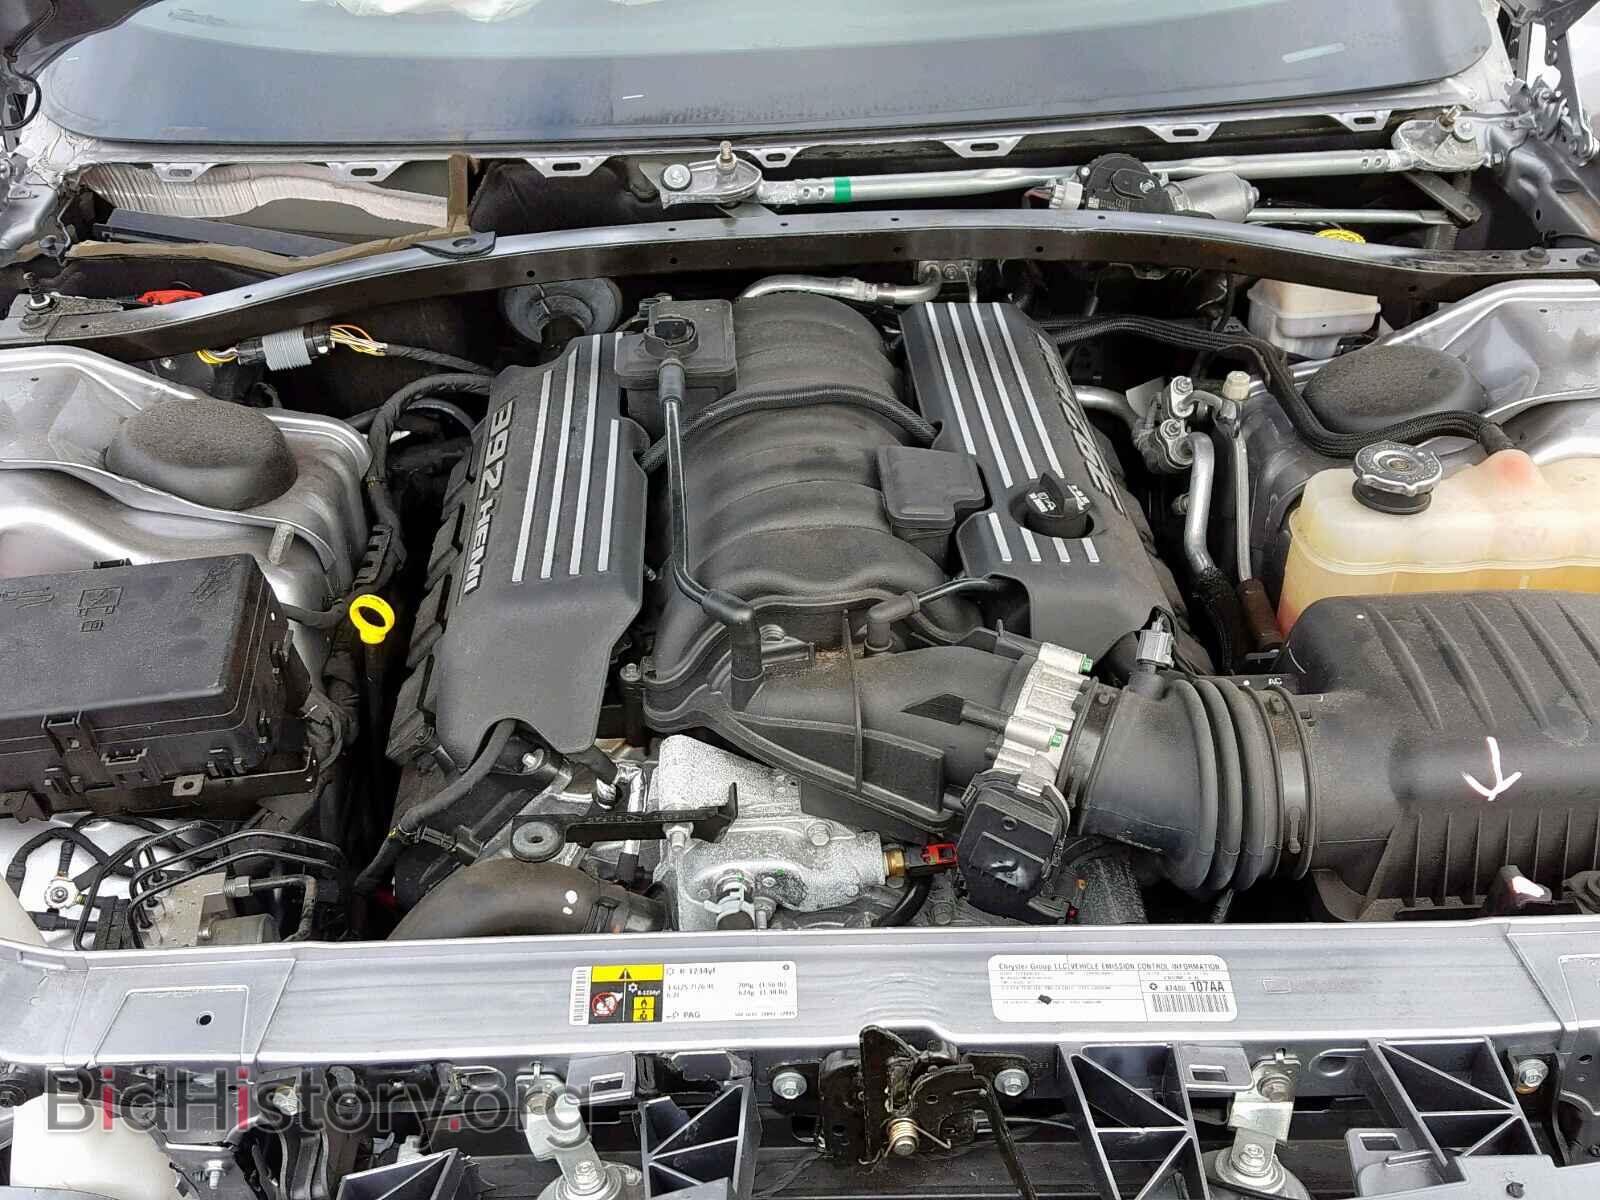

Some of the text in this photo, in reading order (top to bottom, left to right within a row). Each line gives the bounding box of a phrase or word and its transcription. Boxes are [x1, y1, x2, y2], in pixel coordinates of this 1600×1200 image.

[463, 398, 515, 595] 392 HEMI
[998, 962, 1220, 972] Chrysler Group LLC VEHICLE EMISSION CONTROL INFORMATION
[1190, 981, 1225, 992] 107AA
[683, 1010, 702, 1019] PAG
